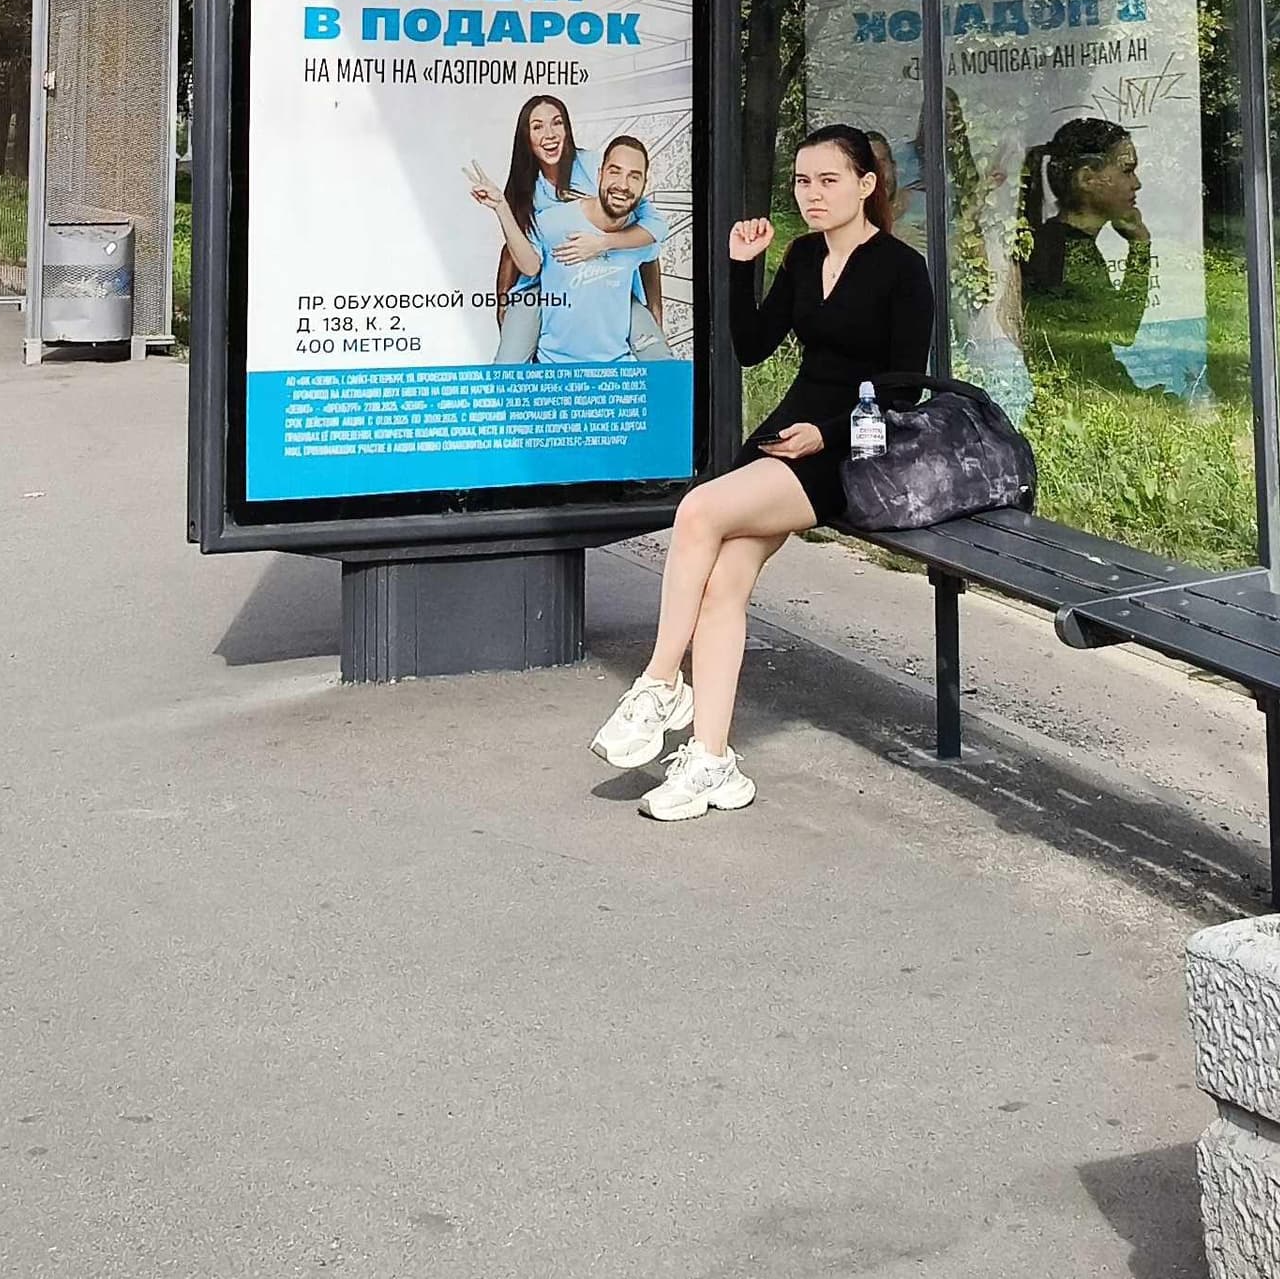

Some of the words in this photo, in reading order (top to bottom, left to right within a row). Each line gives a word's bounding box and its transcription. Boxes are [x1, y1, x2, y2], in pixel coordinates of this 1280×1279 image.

[304, 8, 341, 40] В
[361, 8, 641, 47] ПОДАРОК
[305, 58, 329, 83] НА
[337, 59, 385, 84] МАТЧ
[393, 60, 417, 85] НА
[423, 59, 517, 85] «ГАЗПРОМ
[524, 60, 589, 86] АРЕНЕ»
[298, 295, 326, 311] ПР.
[334, 291, 464, 310] ОБУХОВСКОЙ
[471, 292, 572, 309] ОБОРОНЫ,
[297, 317, 317, 333] Д.
[322, 317, 359, 332] 138,
[366, 317, 384, 331] К.
[389, 316, 406, 331] 2,
[296, 339, 334, 354] 400
[342, 337, 421, 353] МЕТРОВ
